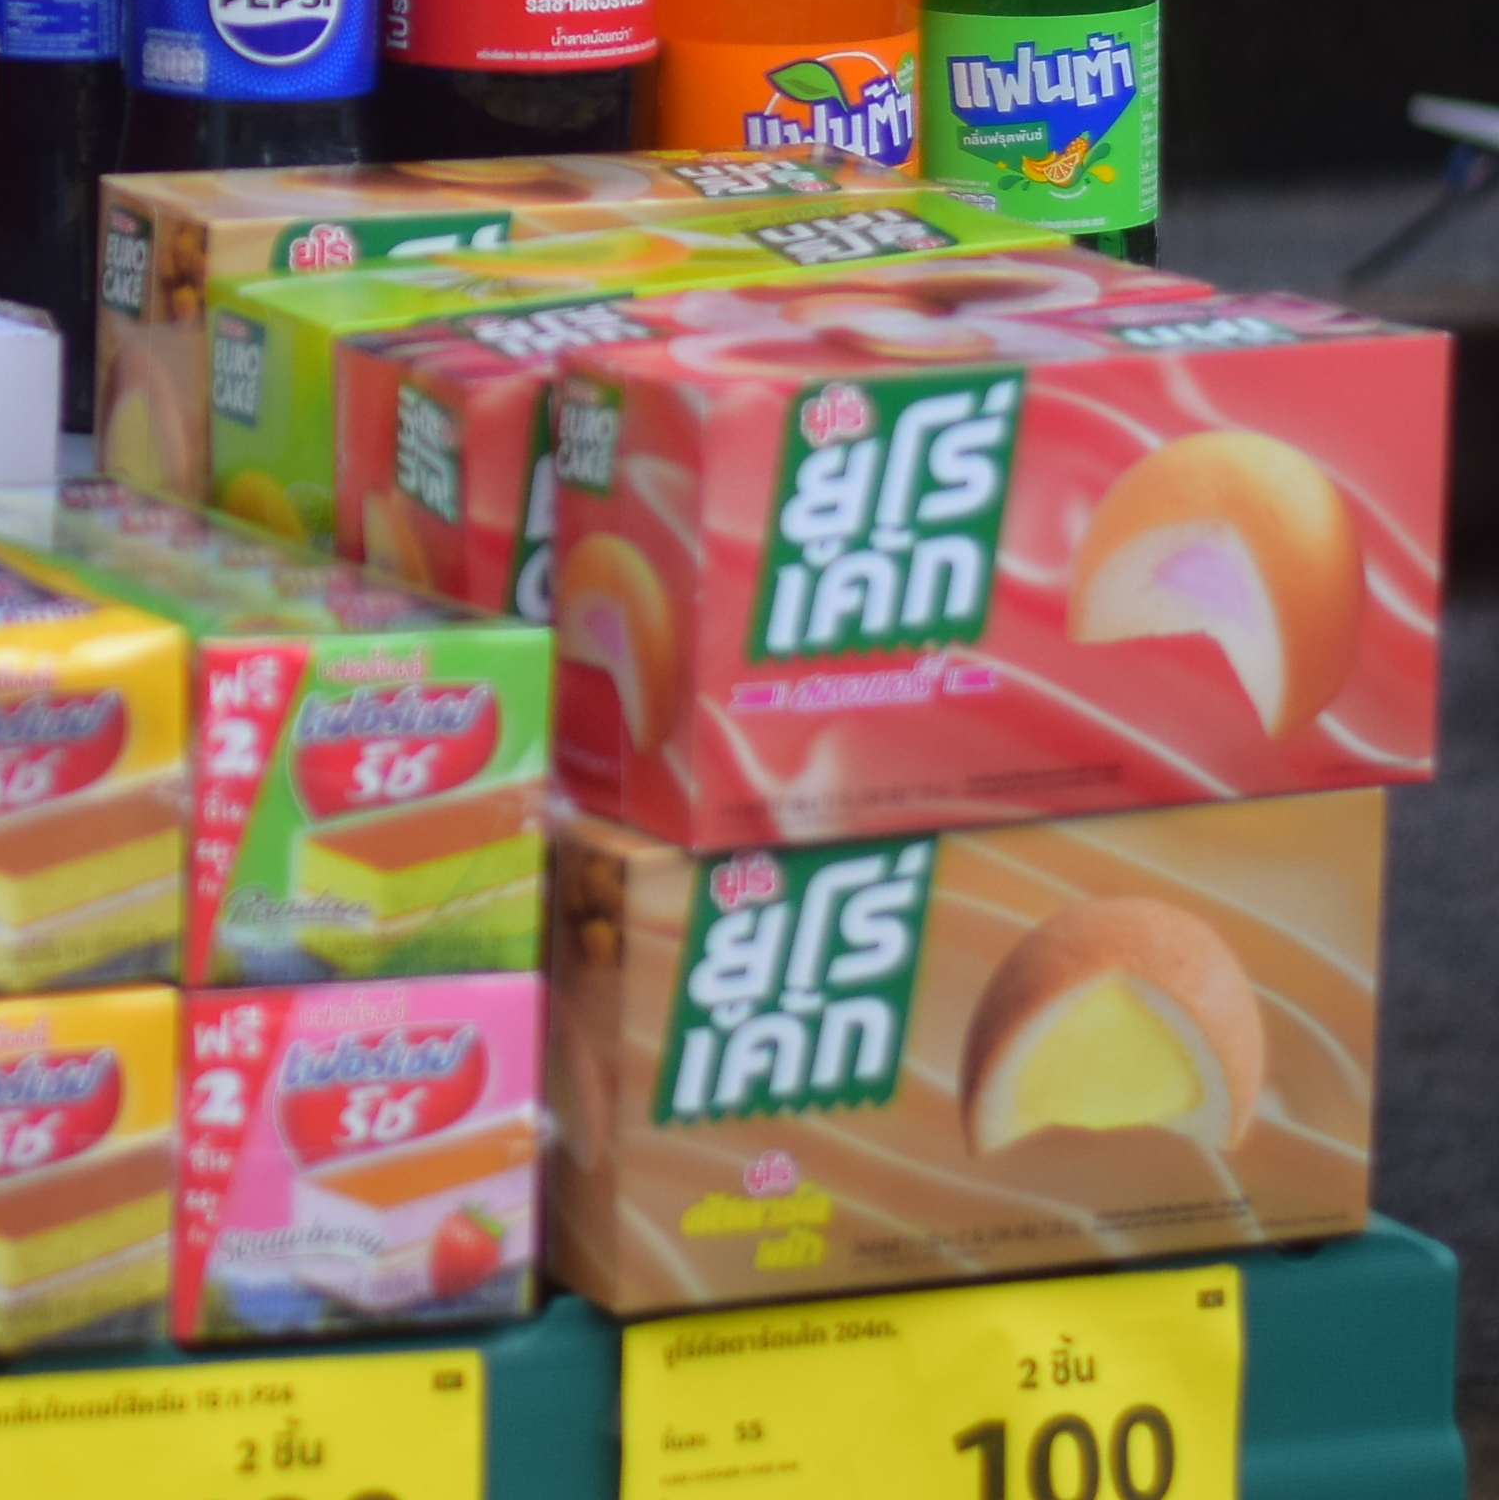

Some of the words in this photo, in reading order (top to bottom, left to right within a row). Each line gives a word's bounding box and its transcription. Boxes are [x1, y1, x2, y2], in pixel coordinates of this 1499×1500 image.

[952, 37, 1134, 112] แฟนต้า
[962, 127, 1043, 148] กลิ่นฟรุตพันช์
[106, 234, 148, 272] EURO
[103, 266, 146, 310] CAKE
[214, 336, 259, 381] EURO
[212, 373, 258, 417] CAKE
[559, 401, 615, 451] EURO
[557, 438, 613, 486] CAKE
[780, 377, 1020, 566] ยูโร่
[766, 524, 981, 655] เค้ก
[209, 653, 281, 711] ฟรี
[208, 720, 259, 776] 2
[351, 740, 441, 799] ริช
[689, 841, 932, 1027] ยูโร่
[193, 1005, 265, 1063] ฟรี
[672, 990, 893, 1115] เค้ก
[194, 1071, 245, 1124] 2
[338, 1085, 418, 1145] ริช
[1018, 1358, 1039, 1390] 2
[1051, 1334, 1095, 1385] ชิ้น
[235, 1440, 259, 1474] 2
[271, 1414, 323, 1470] ชิ้น
[953, 1403, 1175, 1500] 100
